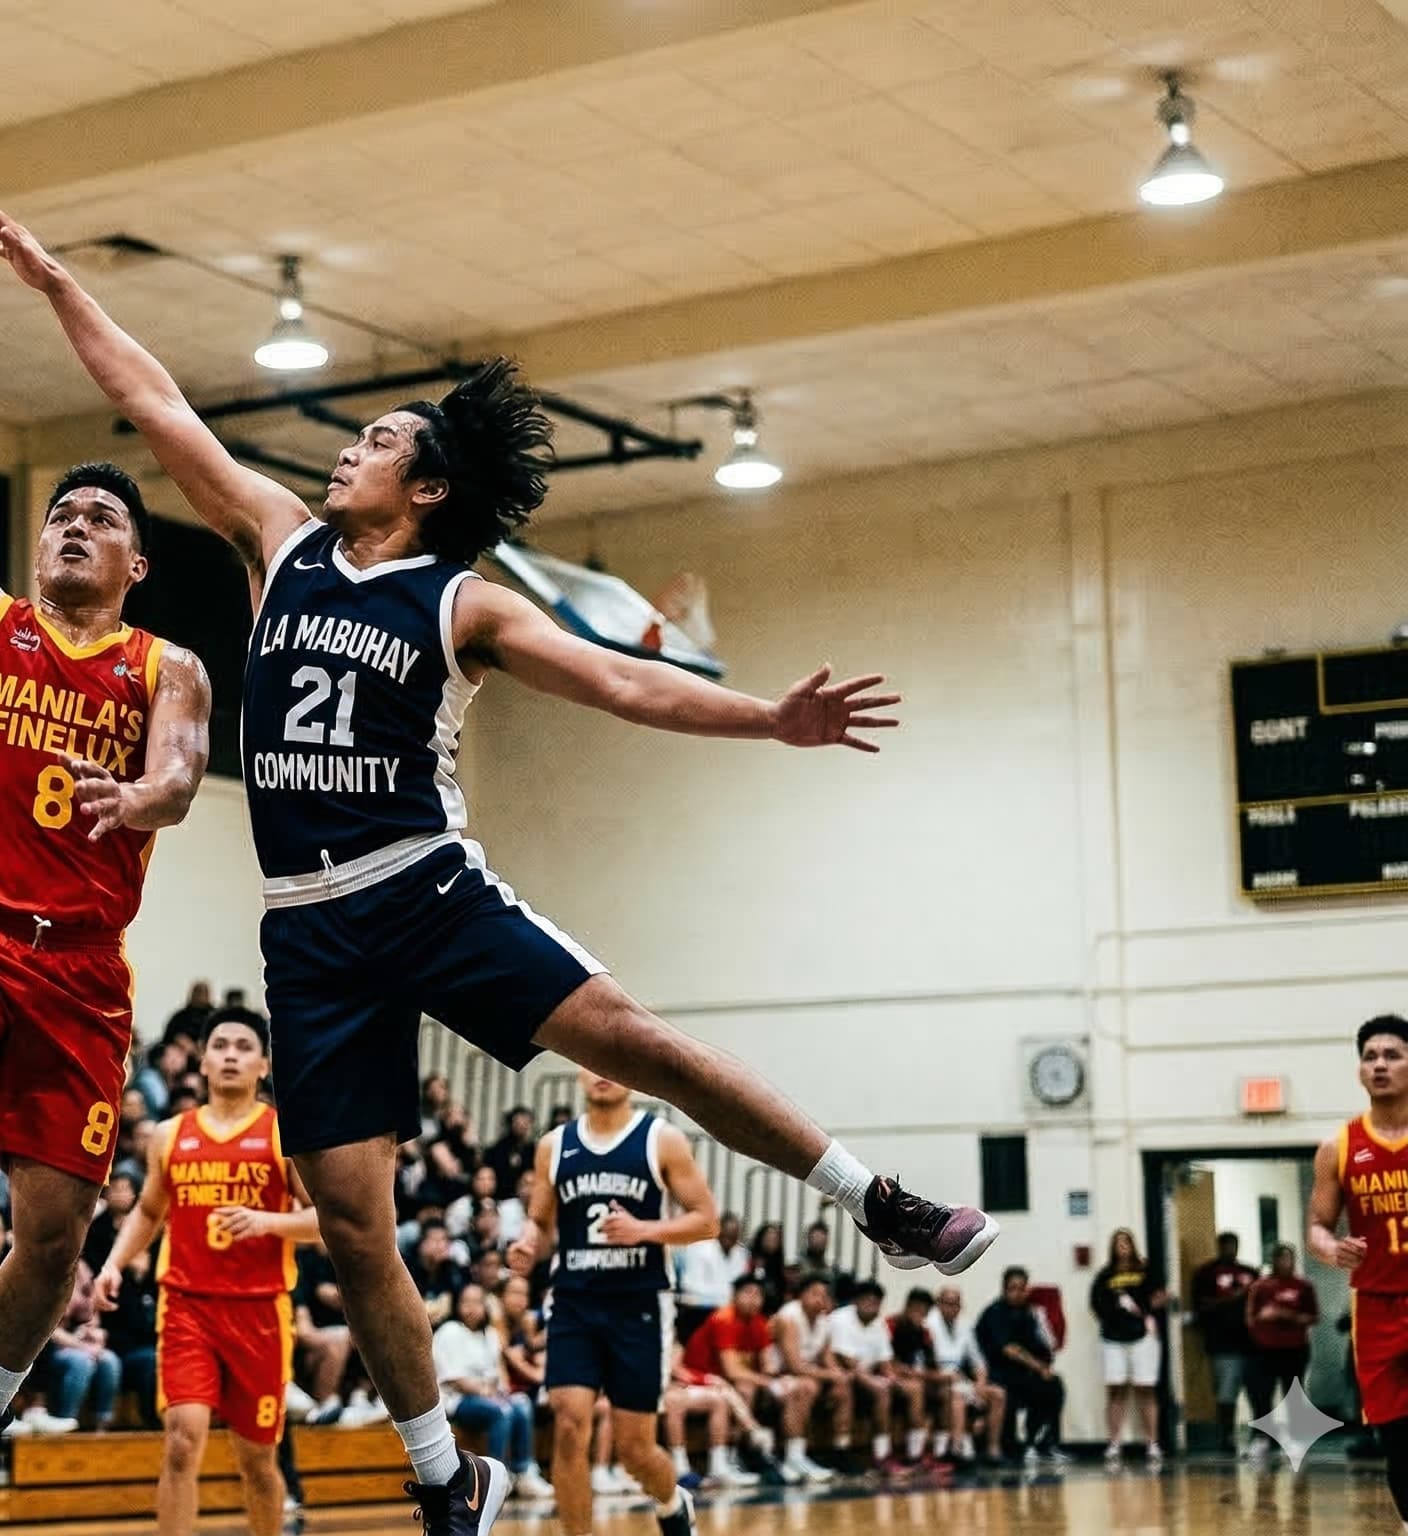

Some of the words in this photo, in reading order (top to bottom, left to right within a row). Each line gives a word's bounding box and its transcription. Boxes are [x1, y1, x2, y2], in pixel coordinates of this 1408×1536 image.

[260, 615, 289, 656] LA
[293, 614, 421, 685] MABUHAY
[283, 665, 357, 747] 21
[33, 765, 74, 830] 8
[254, 752, 400, 792] COMMUNITY
[81, 1101, 114, 1156] 8
[256, 1395, 277, 1427] 8
